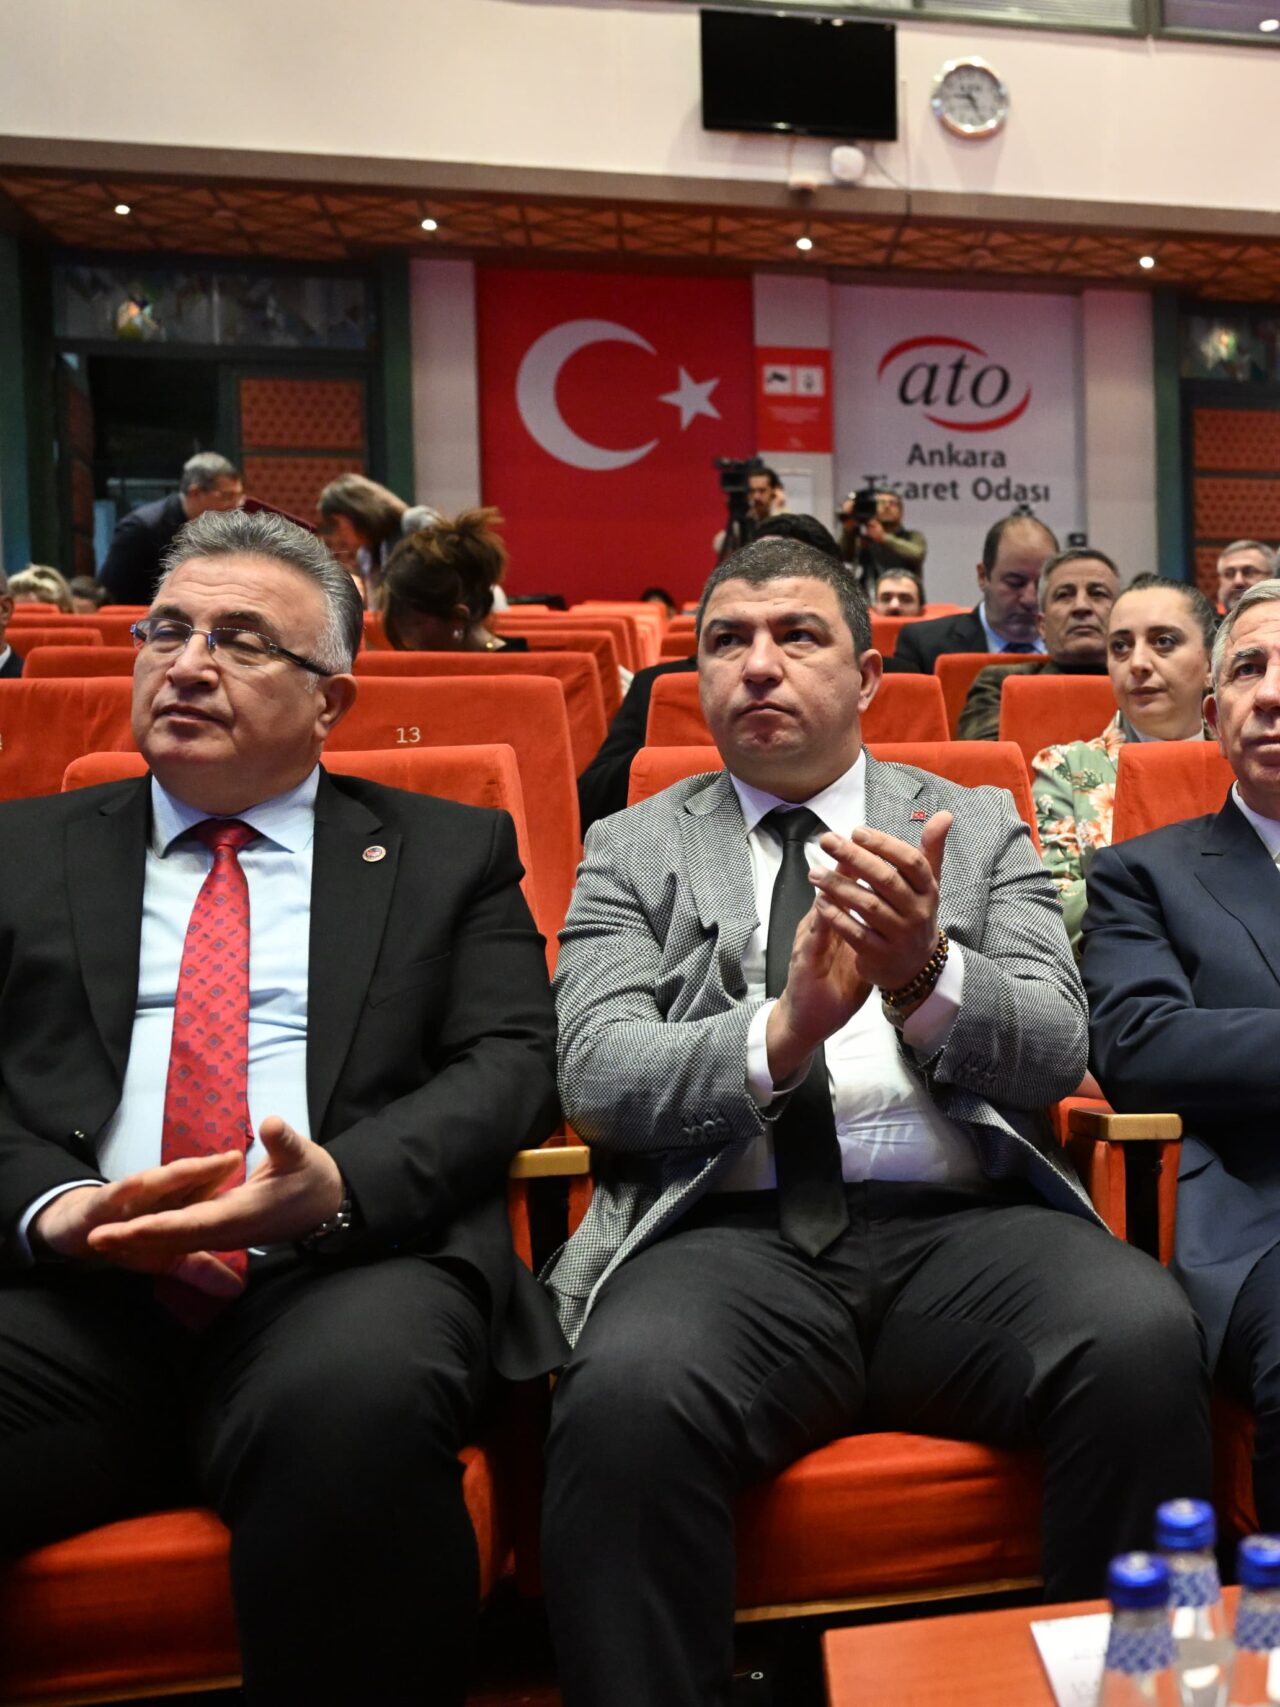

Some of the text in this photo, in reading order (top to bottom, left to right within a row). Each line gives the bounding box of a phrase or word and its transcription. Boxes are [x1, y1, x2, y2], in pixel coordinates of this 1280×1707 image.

[897, 353, 1011, 409] ato
[906, 442, 1007, 468] Ankara
[972, 477, 1050, 503] Odası
[396, 726, 421, 744] 13
